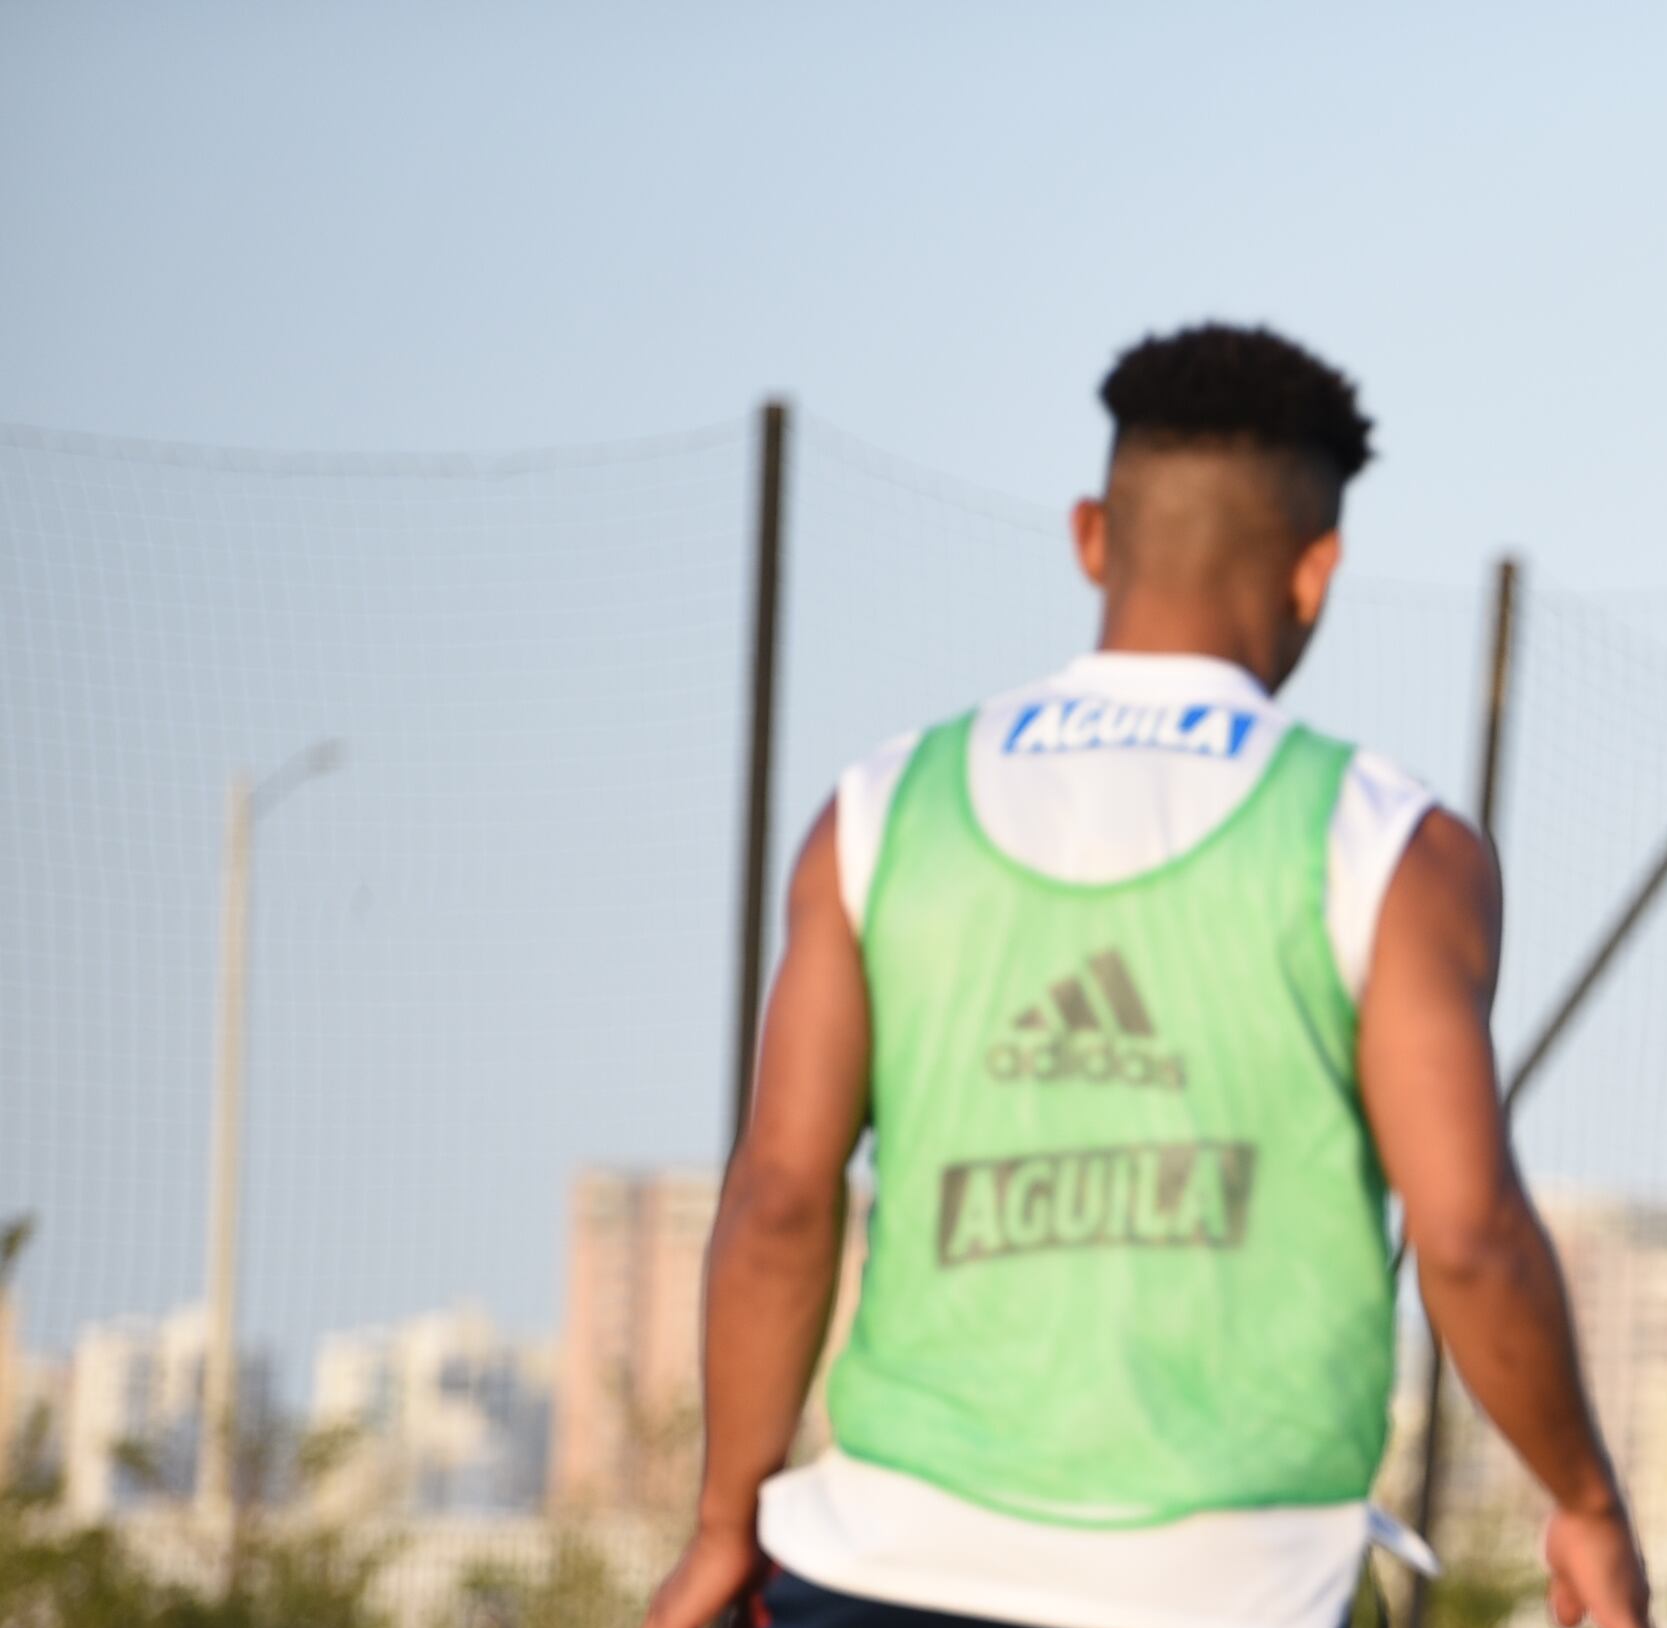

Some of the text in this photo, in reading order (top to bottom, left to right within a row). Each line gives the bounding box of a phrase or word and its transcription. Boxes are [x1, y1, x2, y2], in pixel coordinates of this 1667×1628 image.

[1014, 700, 1234, 755] AGUILA
[984, 1041, 1187, 1090] adidas
[946, 1154, 1234, 1262] AGUILA
